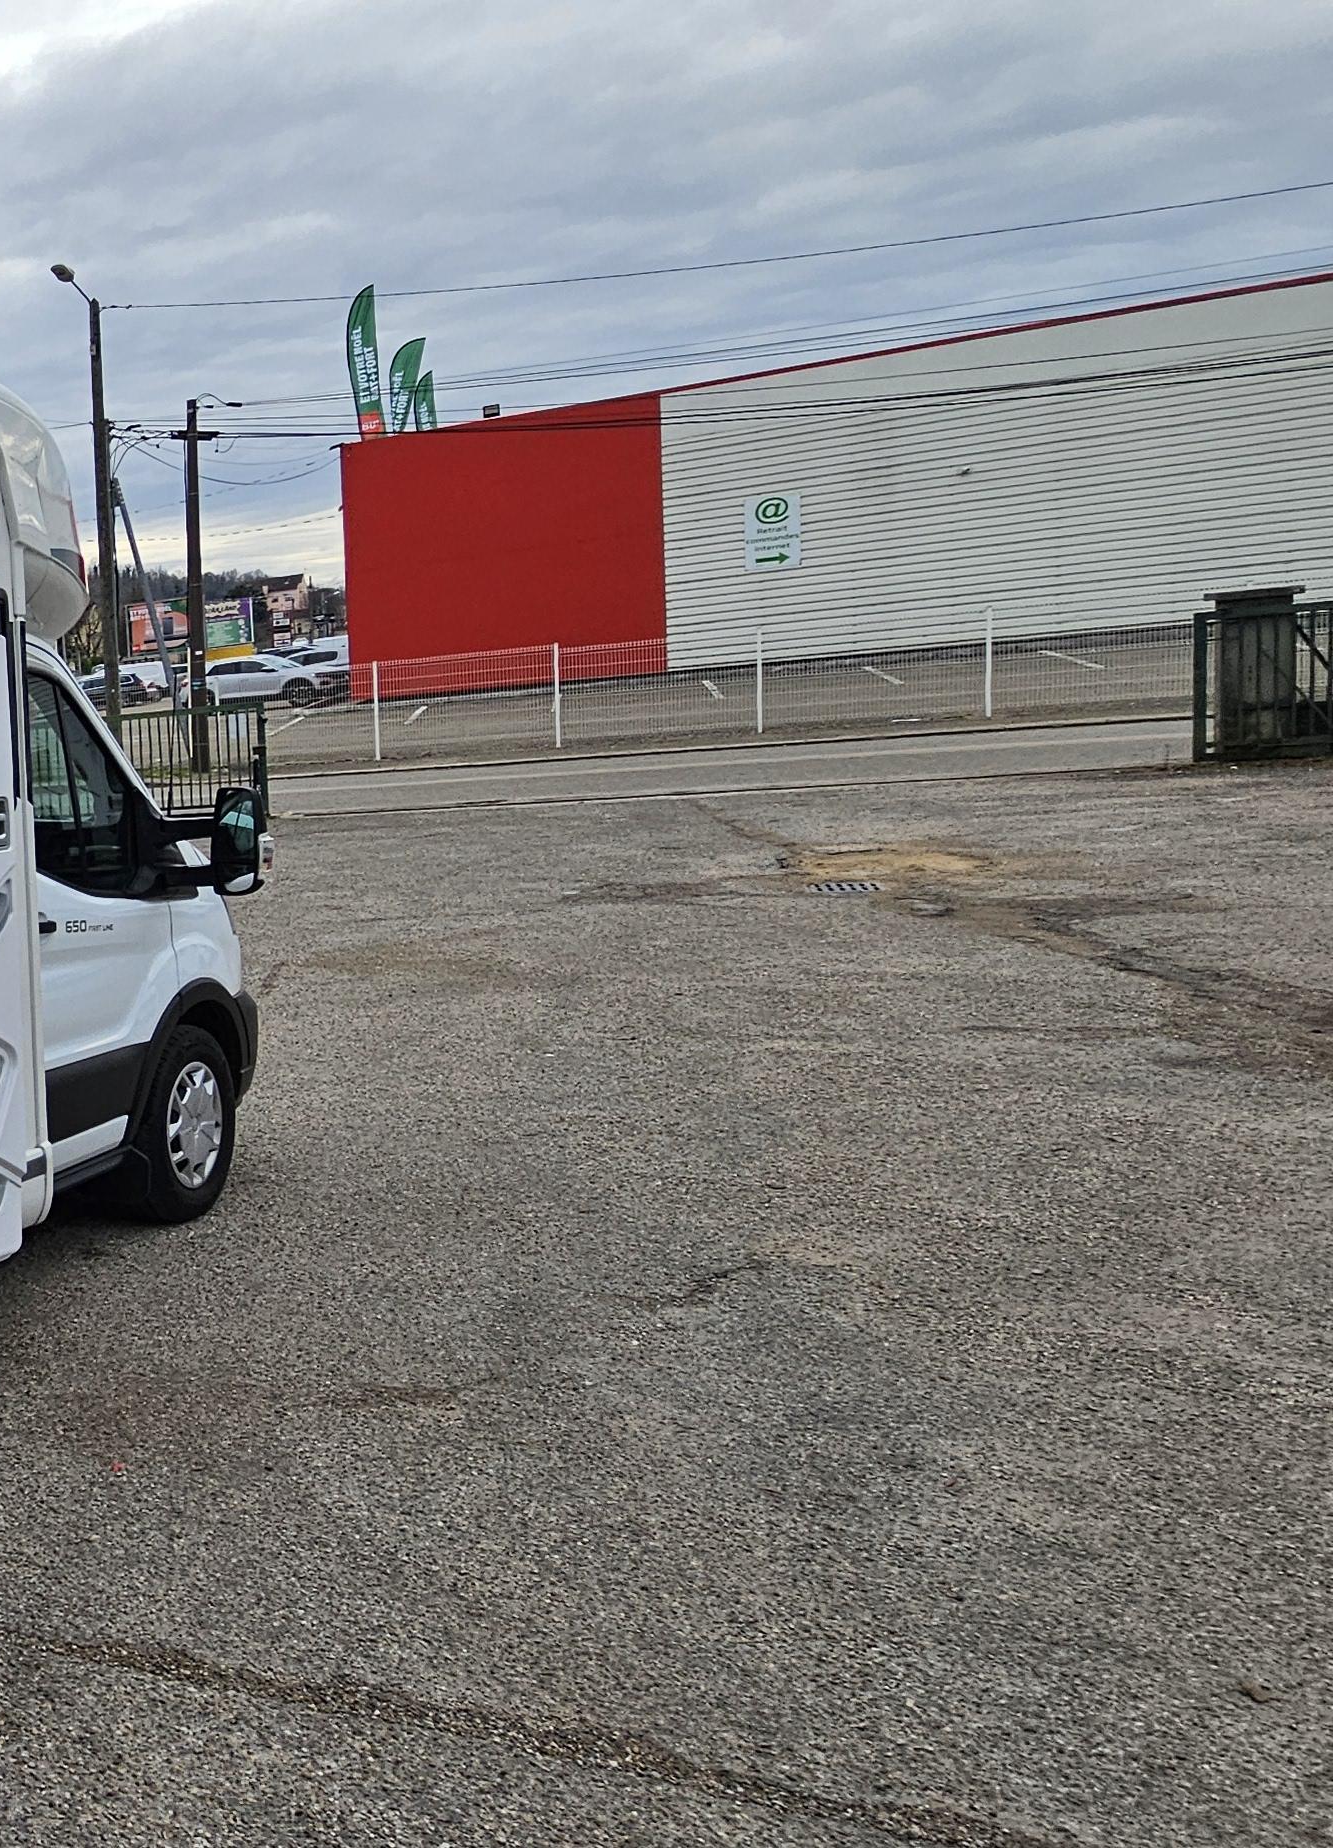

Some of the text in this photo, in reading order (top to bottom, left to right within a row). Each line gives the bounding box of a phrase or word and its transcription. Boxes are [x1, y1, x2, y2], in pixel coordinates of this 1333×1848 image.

[355, 355, 369, 389] VOTRE
[757, 525, 788, 534] Retrait
[66, 920, 86, 932] 650
